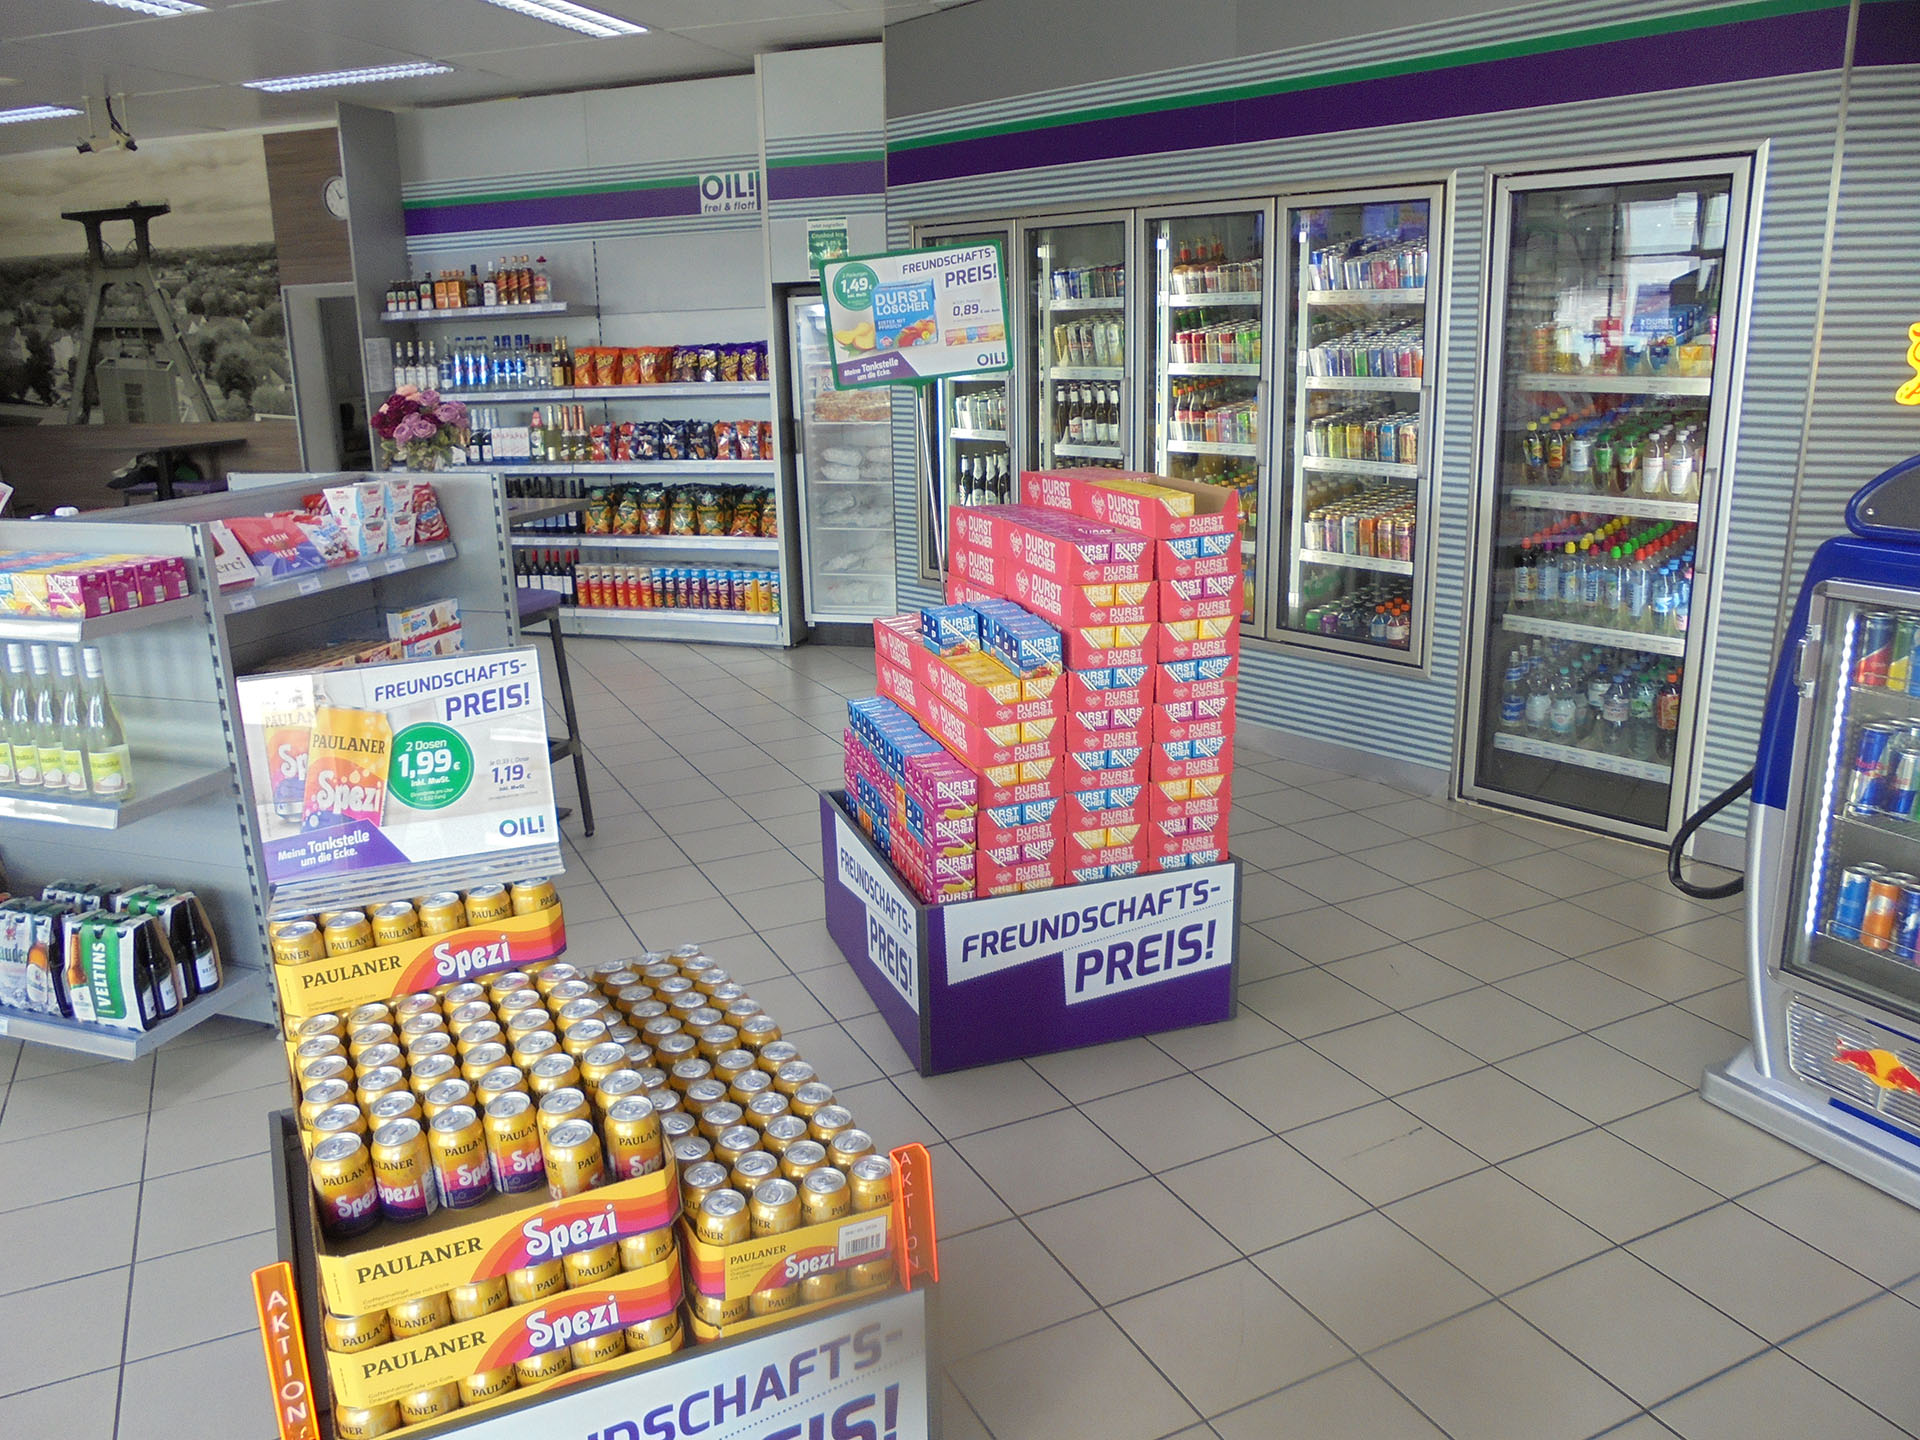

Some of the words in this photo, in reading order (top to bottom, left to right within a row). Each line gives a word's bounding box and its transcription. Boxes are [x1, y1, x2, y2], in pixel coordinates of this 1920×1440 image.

[702, 172, 755, 201] OIL!
[704, 204, 722, 214] frei
[724, 203, 731, 211] &
[902, 247, 996, 275] FREUNDSCHAFTS-
[841, 277, 869, 294] 1,49
[945, 262, 998, 289] PREIS!
[875, 288, 927, 307] DURST
[953, 303, 979, 317] 0,89
[844, 368, 861, 377] Meine
[861, 357, 899, 373] Tankstelle
[976, 351, 1006, 367] OIL!
[1042, 478, 1071, 498] DURST
[1107, 493, 1141, 517] DURST
[968, 515, 993, 536] DURST
[1190, 515, 1224, 527] DURST
[262, 532, 289, 545] MEIN
[1025, 532, 1056, 560] DURST
[215, 556, 246, 574] erci
[968, 551, 994, 573] DURST
[1104, 565, 1139, 576] DURST
[1195, 557, 1229, 569] DURST
[1032, 573, 1062, 599] DURST
[1110, 606, 1144, 617] DURST
[1197, 600, 1231, 612] DURST
[888, 632, 909, 655] DURST
[1192, 640, 1226, 652] DURST
[1108, 649, 1143, 660] DURST
[374, 659, 528, 702] FREUNDSCHAFTS-
[892, 667, 914, 691] DURST
[940, 667, 966, 695] DURST
[1192, 680, 1225, 693] DURST
[445, 682, 531, 722] PREIS!
[1105, 690, 1139, 701] DURST
[1017, 700, 1053, 713] DURST
[940, 705, 966, 734] DURST
[1189, 721, 1222, 734] DURST
[312, 734, 386, 754] PAULANER
[405, 741, 413, 752] 2
[415, 739, 447, 751] Dosen
[1103, 731, 1138, 742] DURST
[1014, 741, 1050, 754] DURST
[398, 749, 452, 779] 1,99
[453, 761, 461, 770] €
[492, 764, 524, 784] 1,19
[1186, 759, 1219, 771] DURST
[1101, 769, 1135, 781] DURST
[316, 770, 381, 815] Spezi
[1015, 782, 1051, 794] DURST
[1101, 808, 1135, 820] DURST
[1185, 798, 1219, 810] DURST
[499, 814, 546, 838] OIL!
[1016, 823, 1052, 835] DURST
[278, 846, 307, 861] Meine
[307, 830, 370, 857] Tankstelle
[1182, 835, 1215, 847] DURST
[300, 857, 317, 867] um
[317, 851, 333, 864] die
[333, 846, 359, 862] Ecke.
[1100, 846, 1134, 858] DURST
[1015, 863, 1051, 875] DURST
[840, 847, 913, 936] FREUNDSCHAFTS-
[938, 890, 975, 903] DURST
[961, 879, 1222, 963] FREUNDSCHAFTS-
[302, 955, 402, 989] PAULANER
[432, 934, 512, 978] Spezi
[870, 913, 914, 998] PREIS!
[1075, 919, 1217, 993] PREIS!
[92, 942, 111, 1008] VELTINS
[511, 1146, 542, 1173] Spe
[356, 1236, 484, 1284] PAULANER
[522, 1203, 618, 1260] Spezi
[730, 1244, 787, 1265] PAULANER
[785, 1247, 835, 1280] Spezi
[362, 1330, 488, 1379] PAULANER
[526, 1294, 620, 1350] Spezi
